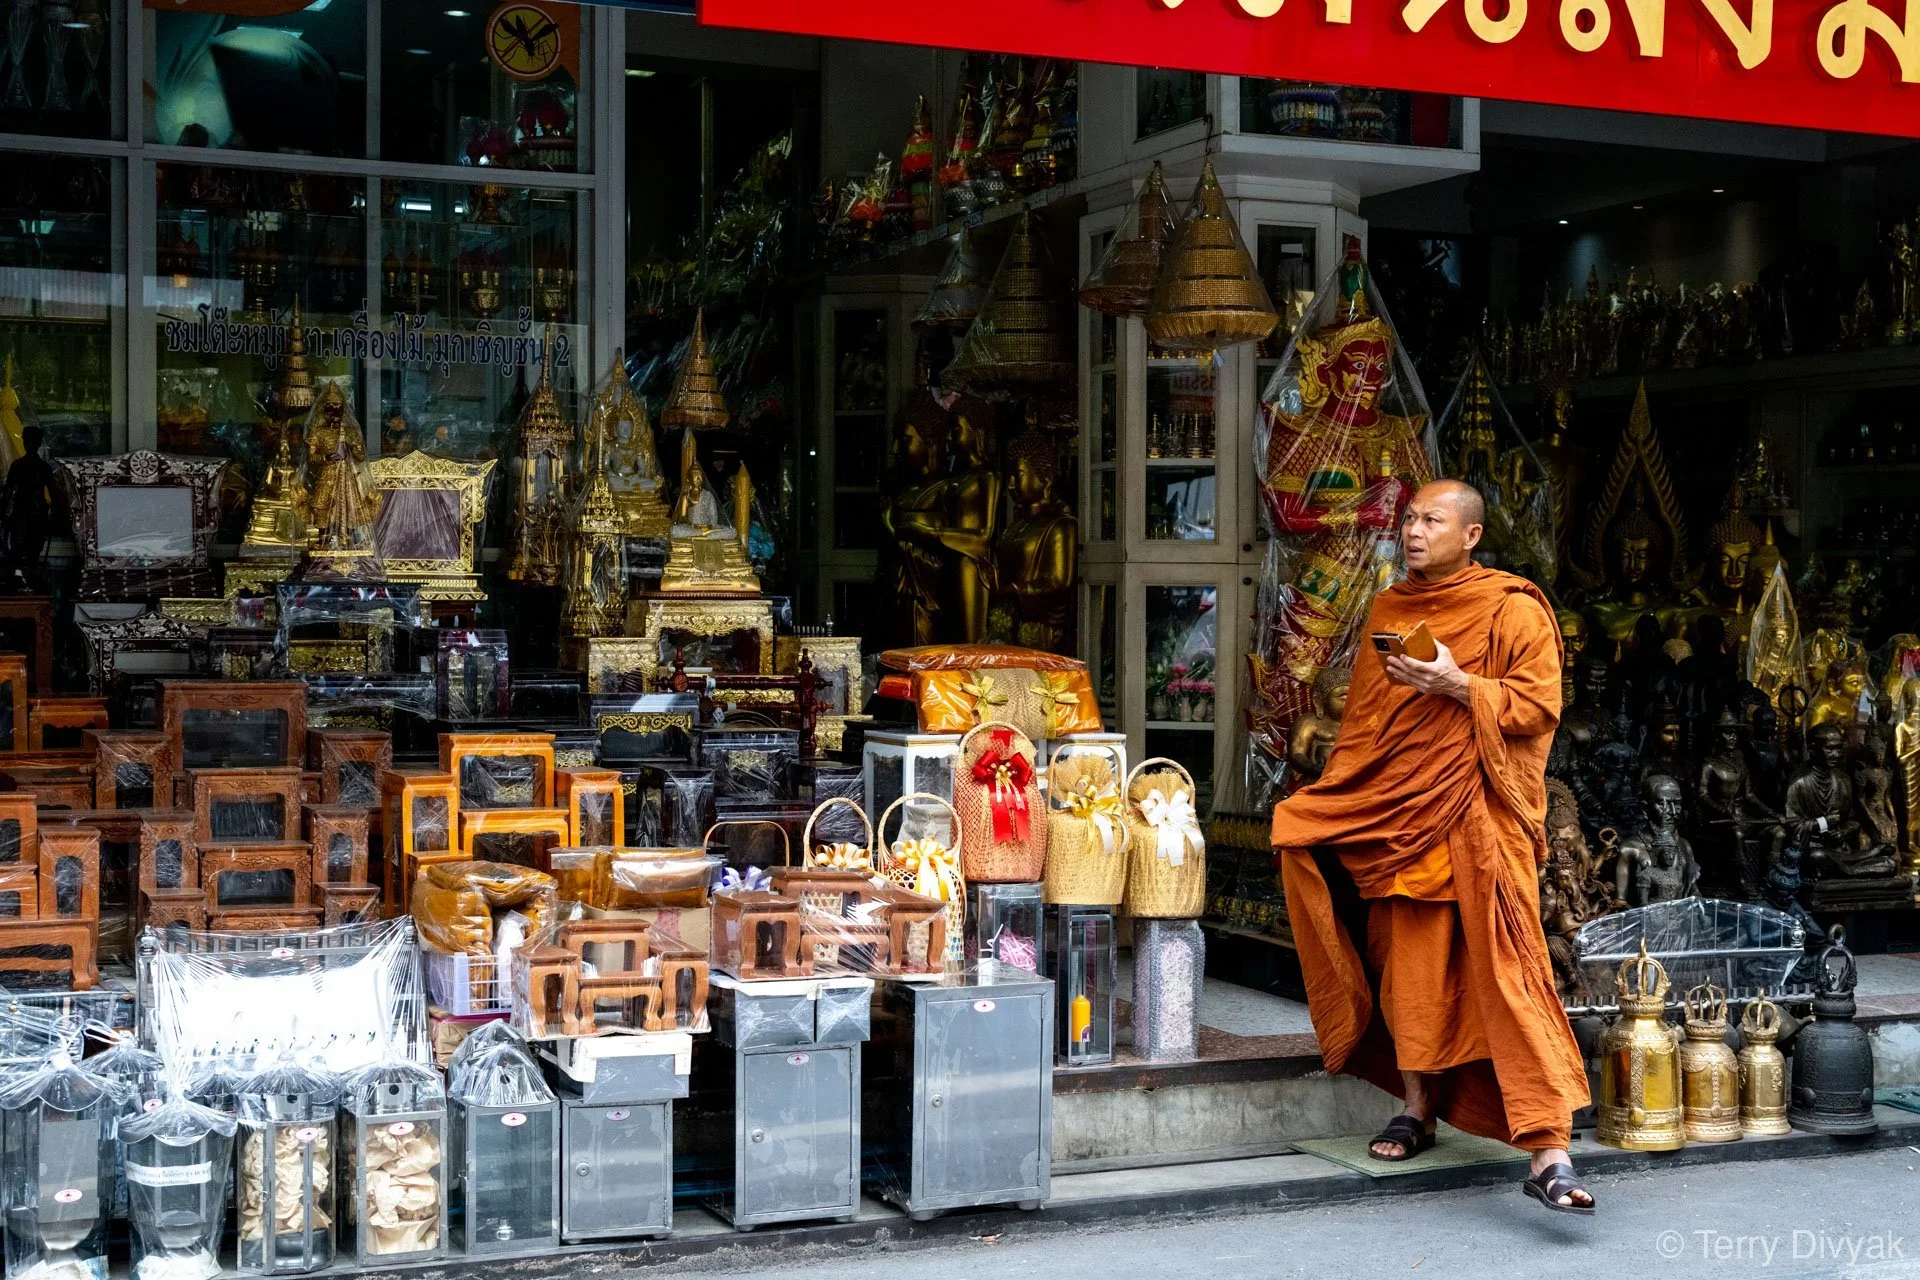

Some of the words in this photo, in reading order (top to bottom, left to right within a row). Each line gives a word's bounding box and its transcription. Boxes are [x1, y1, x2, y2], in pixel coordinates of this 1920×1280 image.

[165, 298, 466, 379] ชมโต๊ะหมู่บา,เครื่องไม้,มุก
[554, 332, 571, 368] 2
